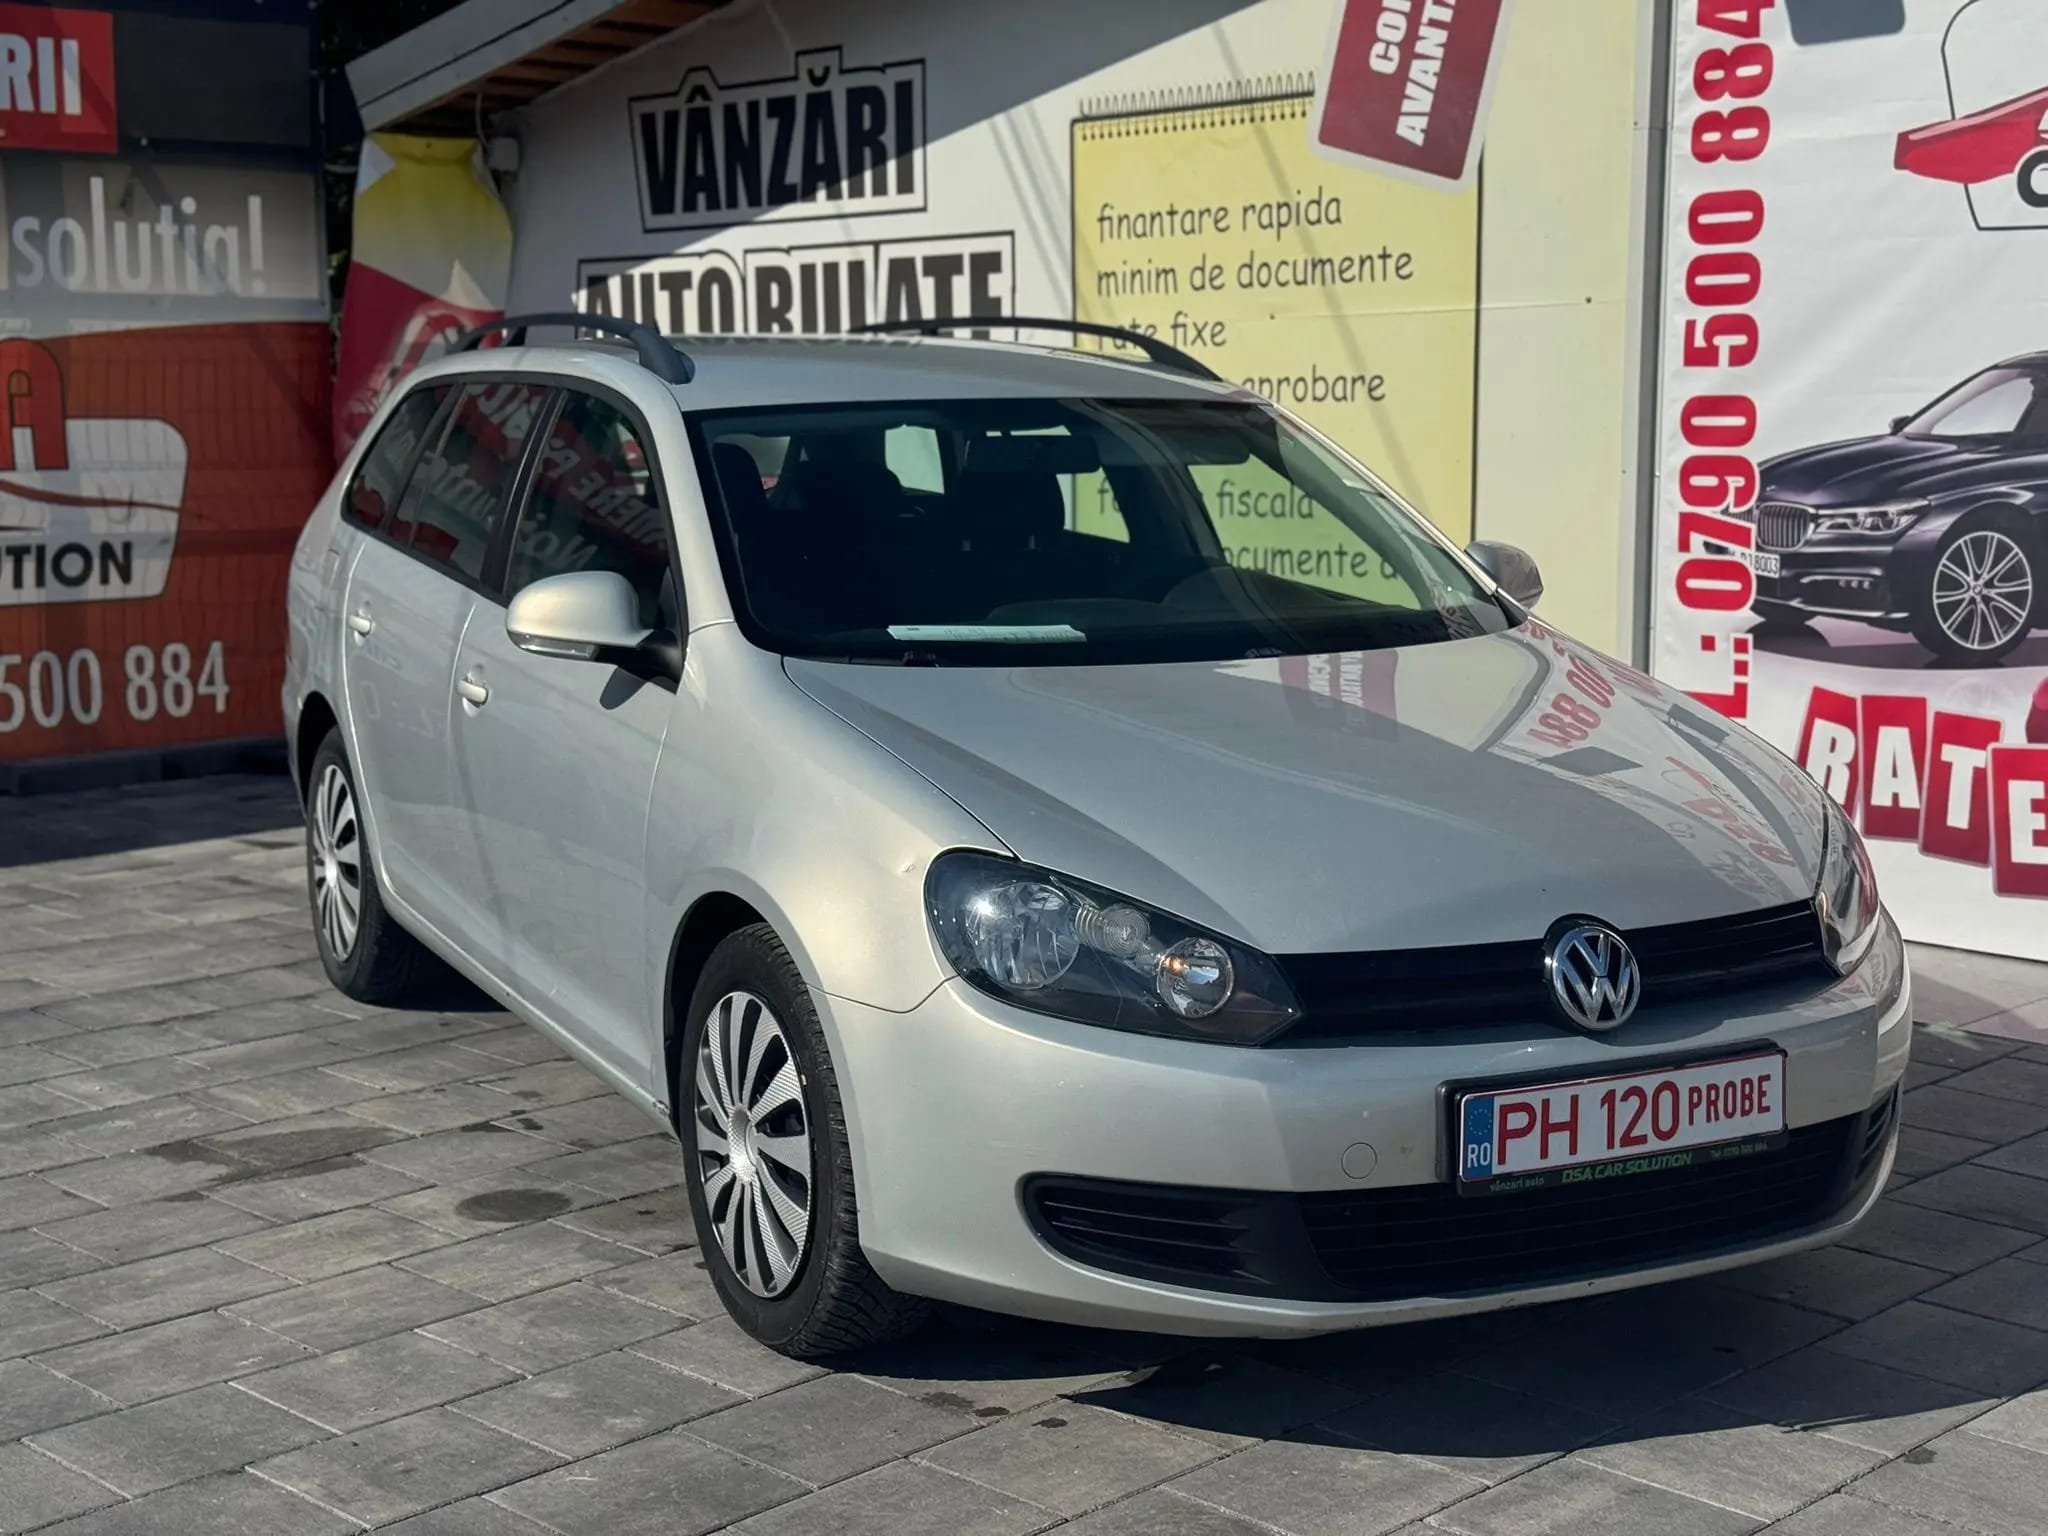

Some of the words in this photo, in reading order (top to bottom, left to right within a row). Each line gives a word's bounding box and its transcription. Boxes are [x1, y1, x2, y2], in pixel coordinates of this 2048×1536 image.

[0, 32, 82, 116] RII
[1690, 0, 1775, 163] 884
[640, 67, 914, 216] VÂNZĂRI
[1097, 202, 1231, 244] finantare
[1242, 185, 1342, 242] rapida
[1096, 258, 1179, 298] minim
[1189, 252, 1225, 292] de
[1236, 245, 1414, 289] documente
[1683, 189, 1765, 367] 500
[1170, 310, 1227, 348] fixe
[1216, 479, 1314, 520] fiscala
[1675, 394, 1757, 612] 0790
[0, 541, 133, 590] TION
[124, 640, 230, 722] 884
[1805, 717, 2048, 865] RATE
[1467, 1143, 1491, 1168] RO
[1497, 1094, 1580, 1166] PH
[1600, 1081, 1680, 1151] 120
[1688, 1074, 1772, 1126] PROBE
[1625, 1153, 1692, 1174] SOLUTION
